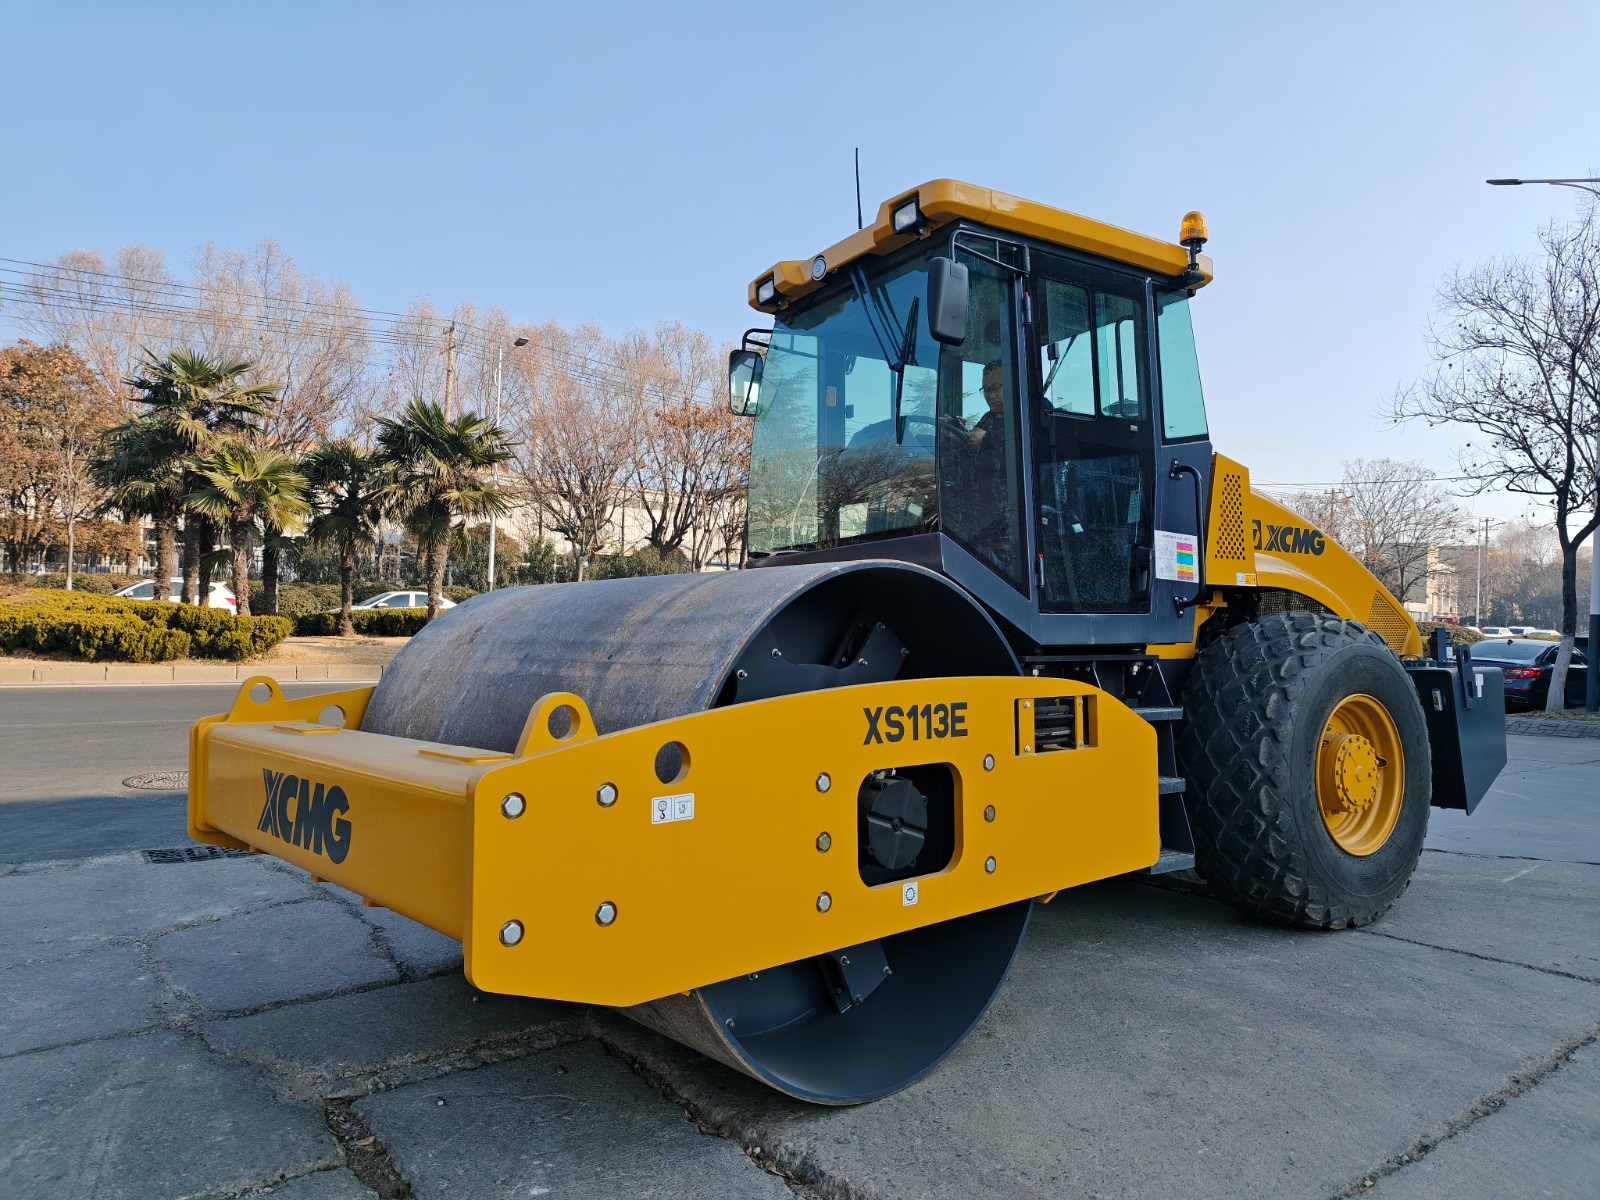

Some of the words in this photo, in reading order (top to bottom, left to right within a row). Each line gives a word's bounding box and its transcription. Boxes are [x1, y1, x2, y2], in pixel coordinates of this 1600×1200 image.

[1264, 524, 1325, 556] XCMG
[863, 702, 968, 746] XS113E
[257, 767, 352, 864] XCMG
